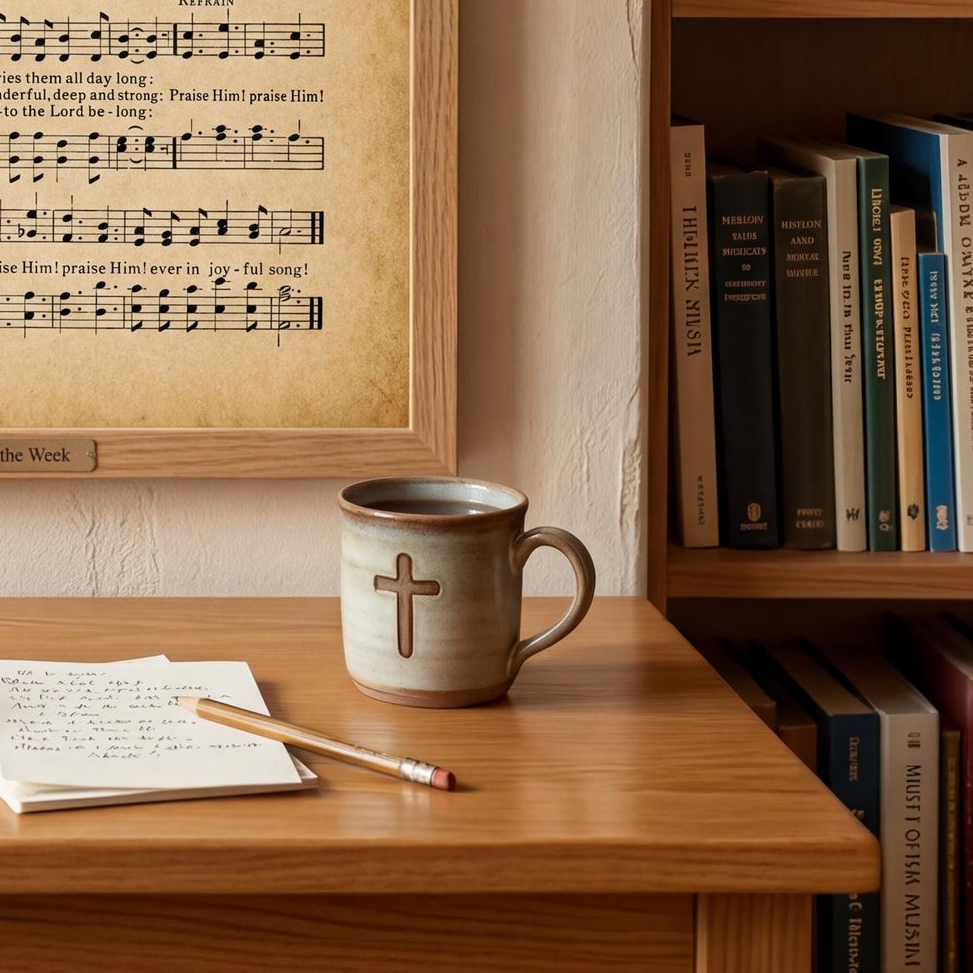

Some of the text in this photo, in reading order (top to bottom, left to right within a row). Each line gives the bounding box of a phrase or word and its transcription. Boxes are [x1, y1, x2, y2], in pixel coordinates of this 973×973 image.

[24, 70, 63, 85] them
[86, 71, 113, 89] day
[115, 71, 154, 89] long:
[52, 87, 87, 106] deep
[89, 88, 116, 103] and
[117, 88, 164, 105] strong:
[168, 88, 210, 102] Praise
[211, 88, 246, 102] Him!
[249, 88, 288, 106] praise
[290, 88, 324, 103] Him!
[21, 104, 46, 118] the
[49, 104, 85, 118] Lord
[21, 259, 59, 275] Him!
[61, 260, 107, 278] praise
[109, 260, 147, 275] Him!
[149, 265, 183, 276] ever
[268, 262, 308, 279] song!
[0, 446, 24, 463] the
[26, 446, 71, 463] Week
